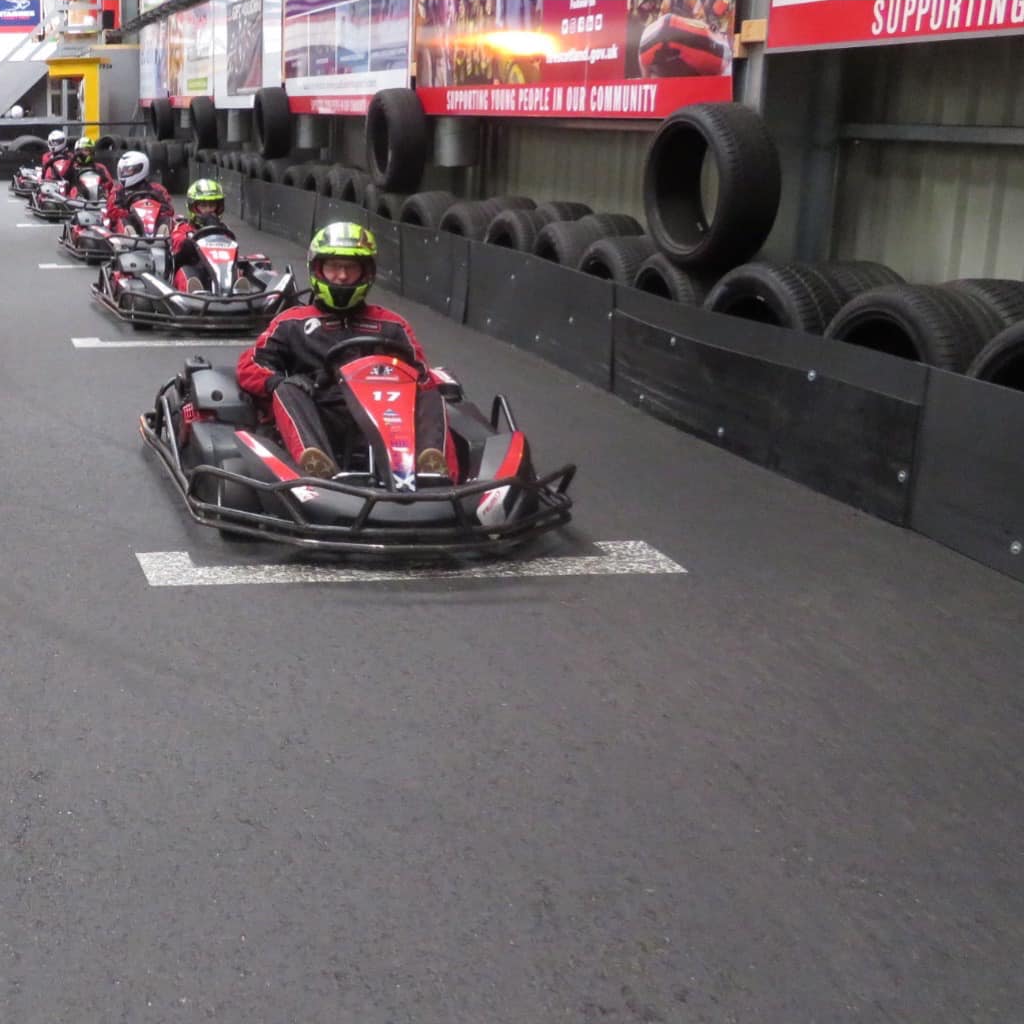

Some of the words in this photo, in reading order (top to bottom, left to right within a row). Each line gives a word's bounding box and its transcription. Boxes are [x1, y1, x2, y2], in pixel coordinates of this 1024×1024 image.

[872, 0, 1024, 35] SUPPORTING
[446, 89, 488, 110] SUPPORTING
[489, 88, 516, 110] YOUNG
[518, 87, 550, 111] PEOPLE
[552, 86, 562, 111] IN
[566, 85, 586, 111] OUR
[590, 84, 657, 113] COMMUNITY
[372, 390, 401, 402] 17
